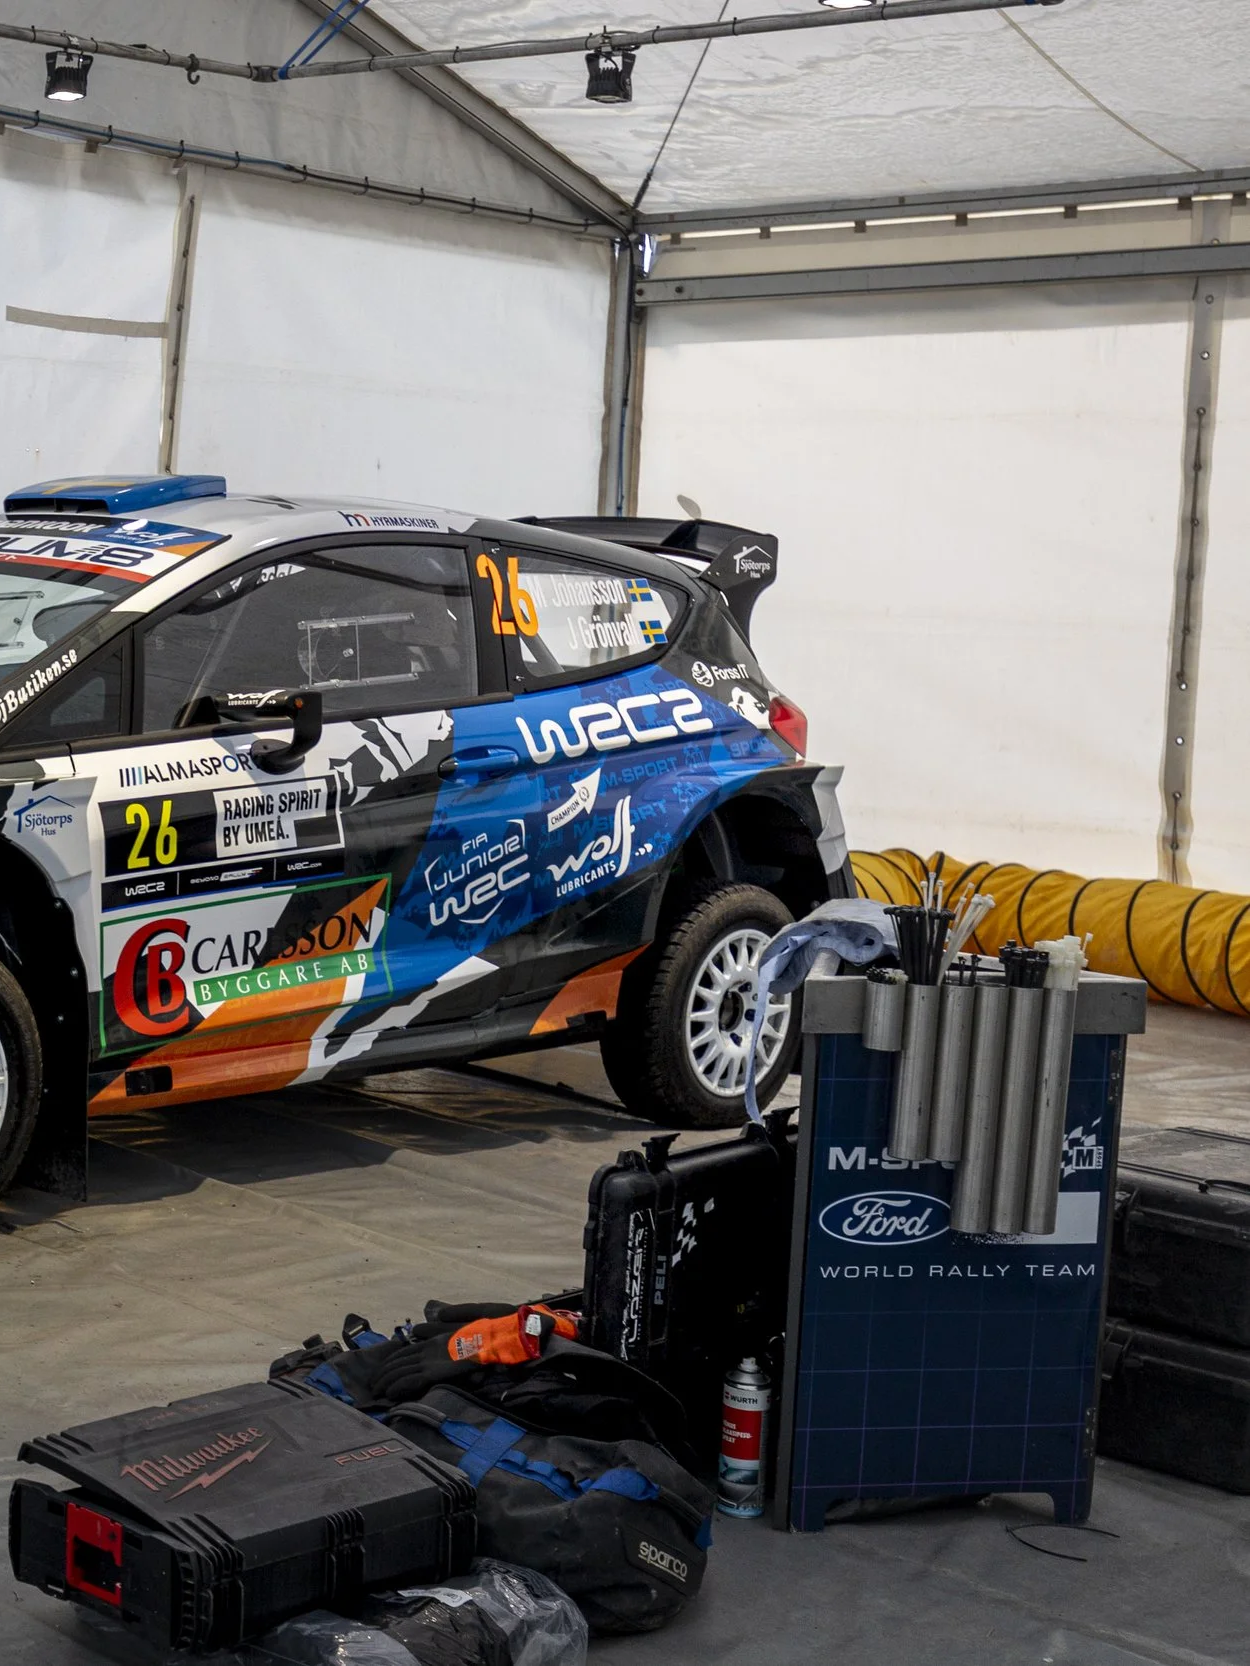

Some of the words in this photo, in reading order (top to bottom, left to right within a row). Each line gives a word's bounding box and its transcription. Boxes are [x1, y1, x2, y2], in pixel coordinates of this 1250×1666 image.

[370, 517, 439, 529] HYRMASKINER
[476, 554, 538, 637] 26
[550, 574, 627, 608] Johansson
[567, 617, 579, 648] J
[579, 612, 641, 649] Grönvall
[711, 666, 738, 681] Forss
[737, 664, 749, 679] IT
[514, 687, 714, 765] WRC2
[143, 751, 253, 781] ALMASPOR
[222, 796, 275, 820] RACING
[278, 788, 321, 811] SPIRIT
[551, 801, 580, 825] CHAMPION
[25, 813, 73, 830] Sjötorps
[41, 828, 56, 837] Hus
[125, 800, 178, 870] 26
[222, 829, 240, 848] BY
[245, 817, 290, 844] UMEÅ.
[462, 832, 488, 855] FIA
[434, 834, 521, 891] JUNIOR
[556, 860, 617, 897] LUBRICANTS
[125, 881, 165, 896] WRC2
[429, 853, 531, 926] WRC
[200, 960, 324, 1002] BYGGARE
[340, 953, 368, 973] AB
[1075, 1149, 1094, 1167] M
[842, 1198, 933, 1237] Ford
[654, 1255, 667, 1305] PELI
[820, 1265, 914, 1278] WORLD
[929, 1265, 1010, 1277] RALLY
[1025, 1264, 1095, 1277] TEAM
[120, 1426, 265, 1492] Milwaukee
[334, 1443, 402, 1467] FUEL
[638, 1541, 687, 1578] sparco
